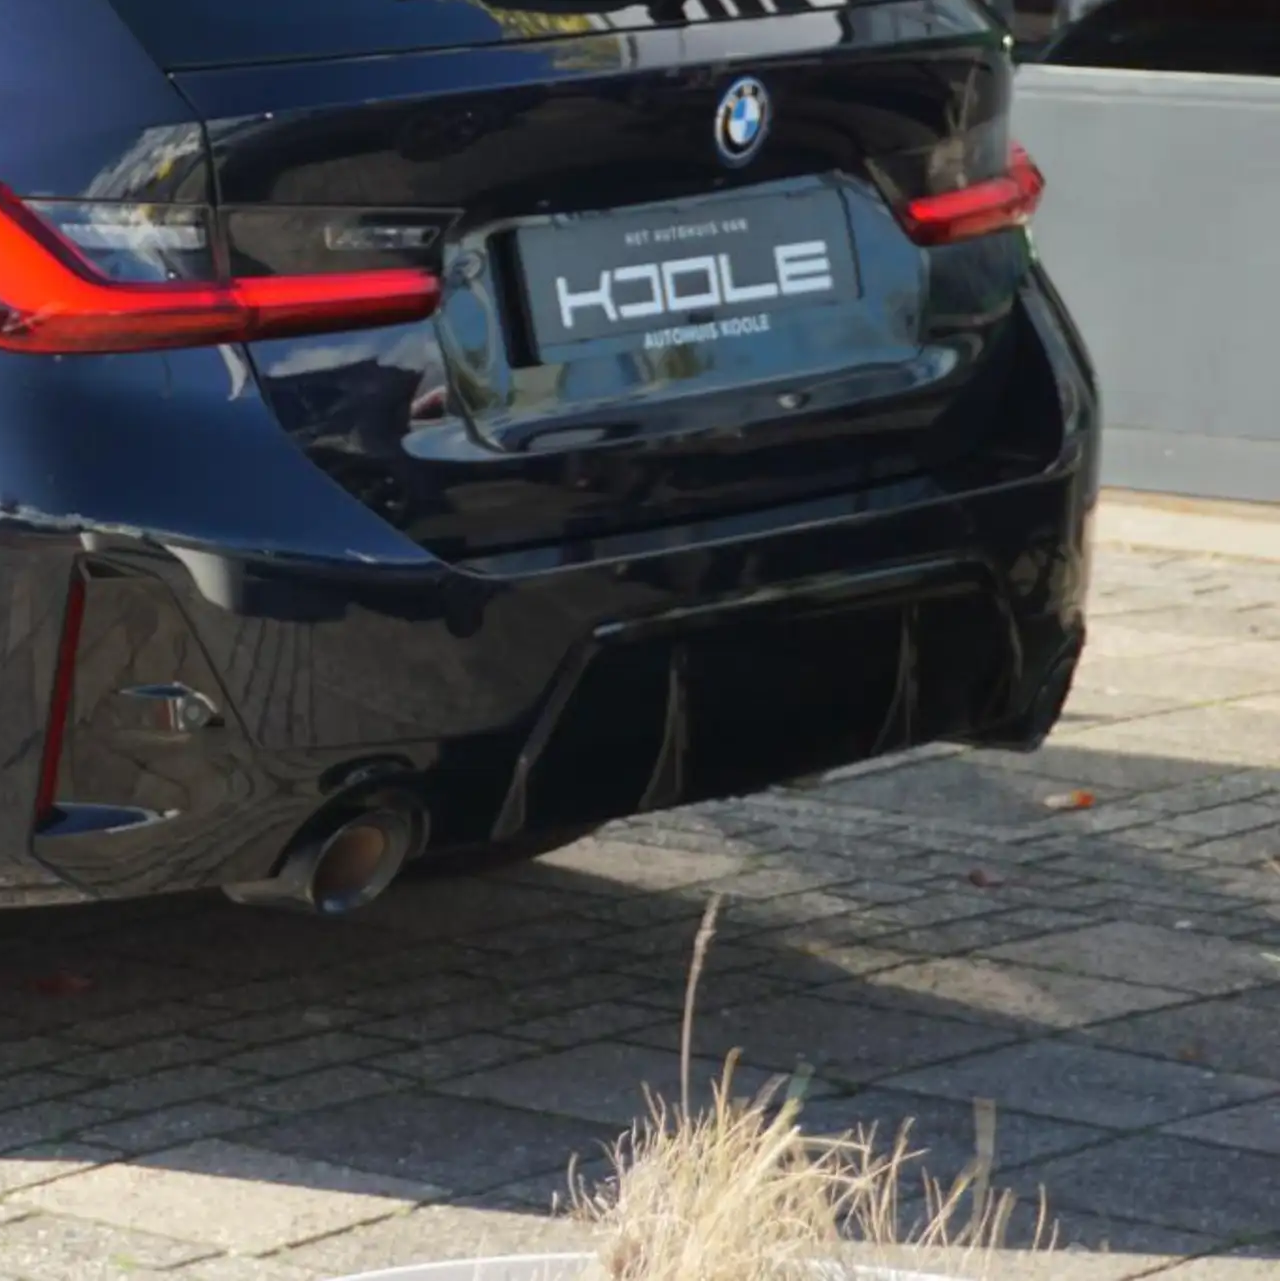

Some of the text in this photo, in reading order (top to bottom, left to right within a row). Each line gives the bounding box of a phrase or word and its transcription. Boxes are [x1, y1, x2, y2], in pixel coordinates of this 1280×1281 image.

[555, 239, 834, 330] KOOLE
[643, 313, 771, 350] AUTOHUIS KOOLE
